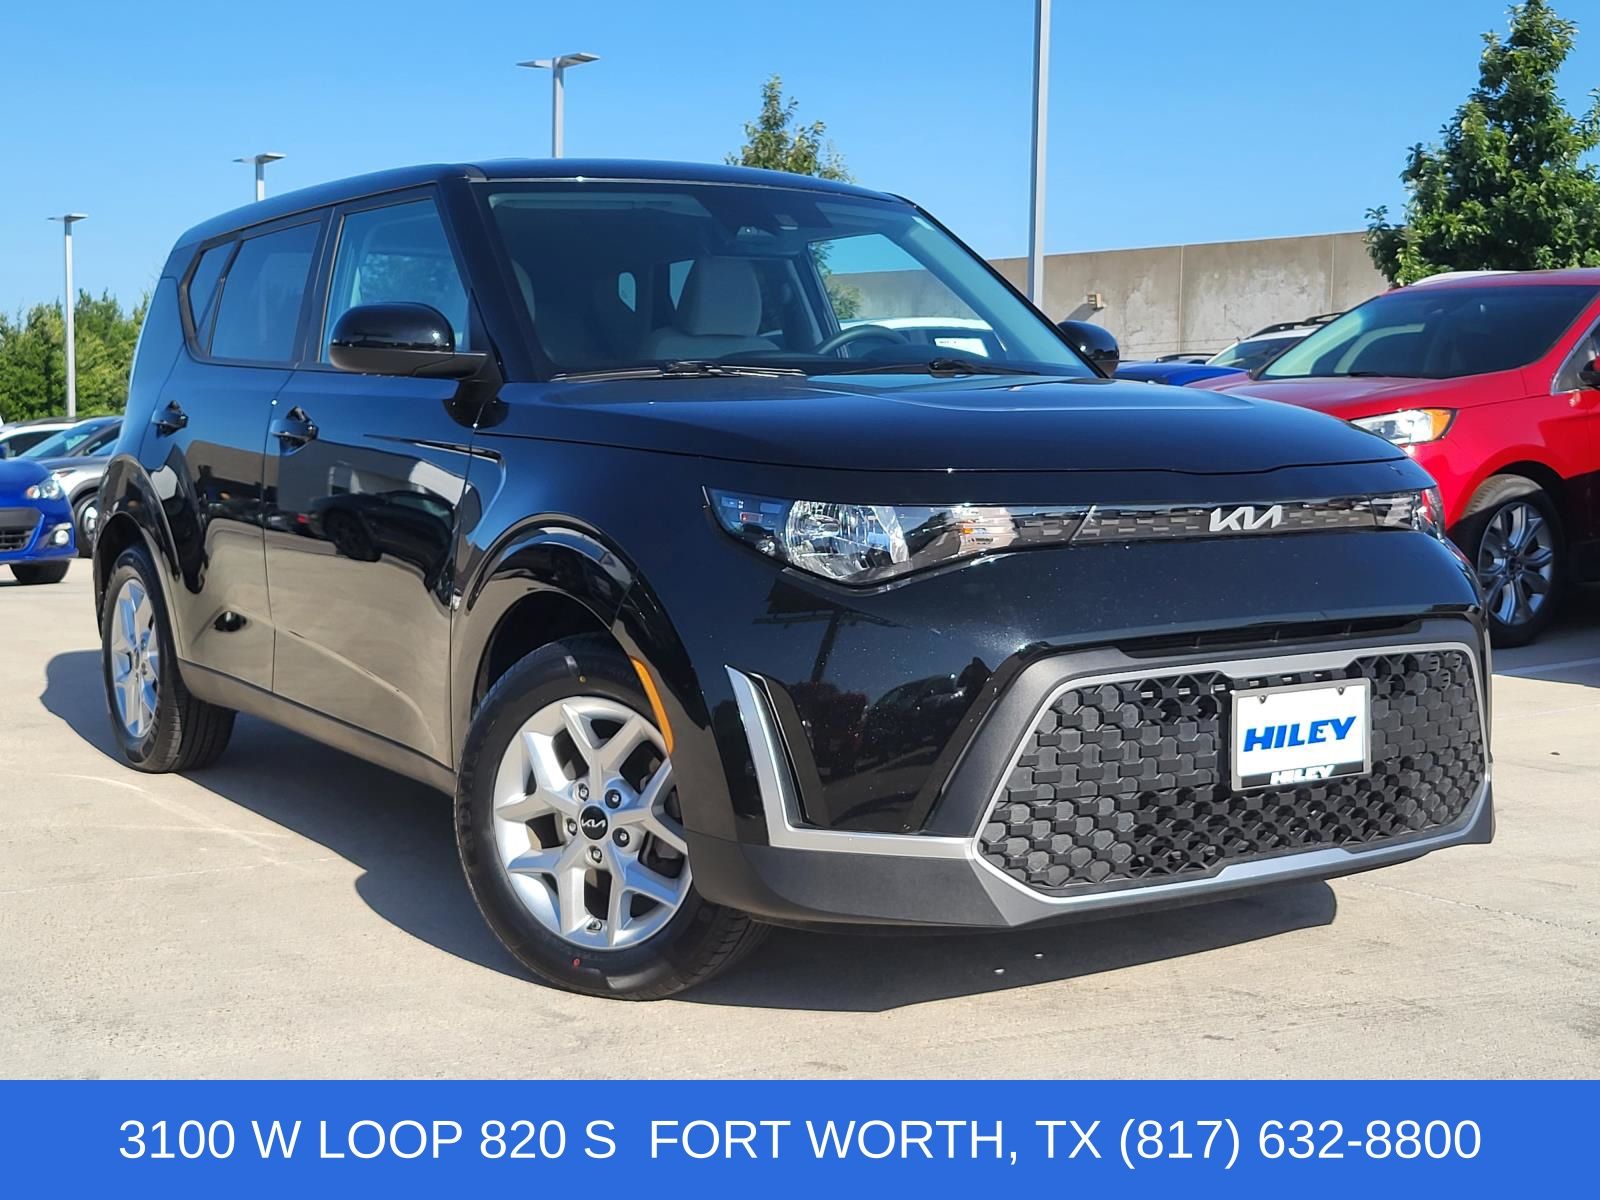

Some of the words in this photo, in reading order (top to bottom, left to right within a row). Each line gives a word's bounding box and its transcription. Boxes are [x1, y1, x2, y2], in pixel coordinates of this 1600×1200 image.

[1209, 505, 1282, 532] KIA
[1243, 716, 1357, 752] HILEY
[1270, 764, 1336, 785] HILEY
[581, 818, 606, 828] KIA
